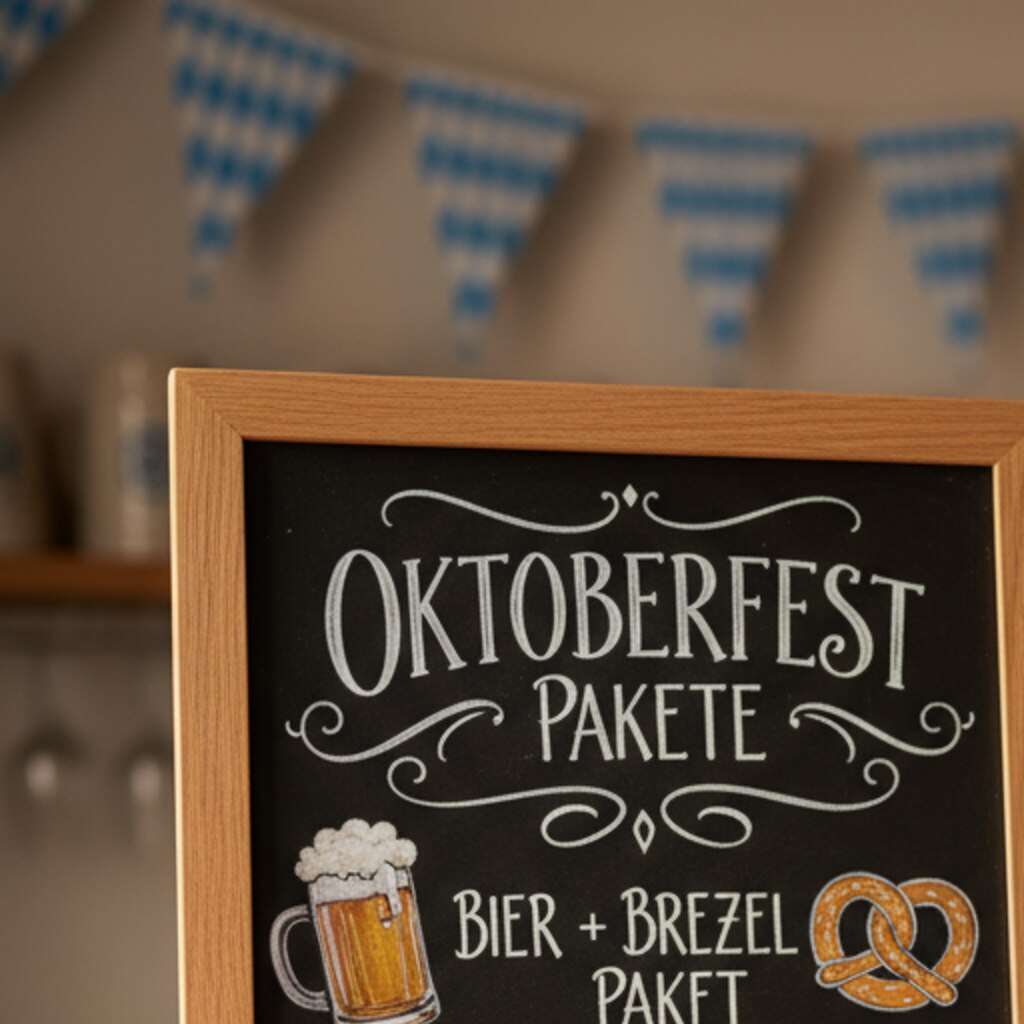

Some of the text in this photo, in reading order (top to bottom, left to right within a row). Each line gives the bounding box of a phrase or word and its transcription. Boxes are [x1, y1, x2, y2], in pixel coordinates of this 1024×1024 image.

[324, 549, 925, 697] OKTOBERFEST
[533, 674, 767, 763] PAKETE
[452, 887, 799, 960] BIER + BREZEL
